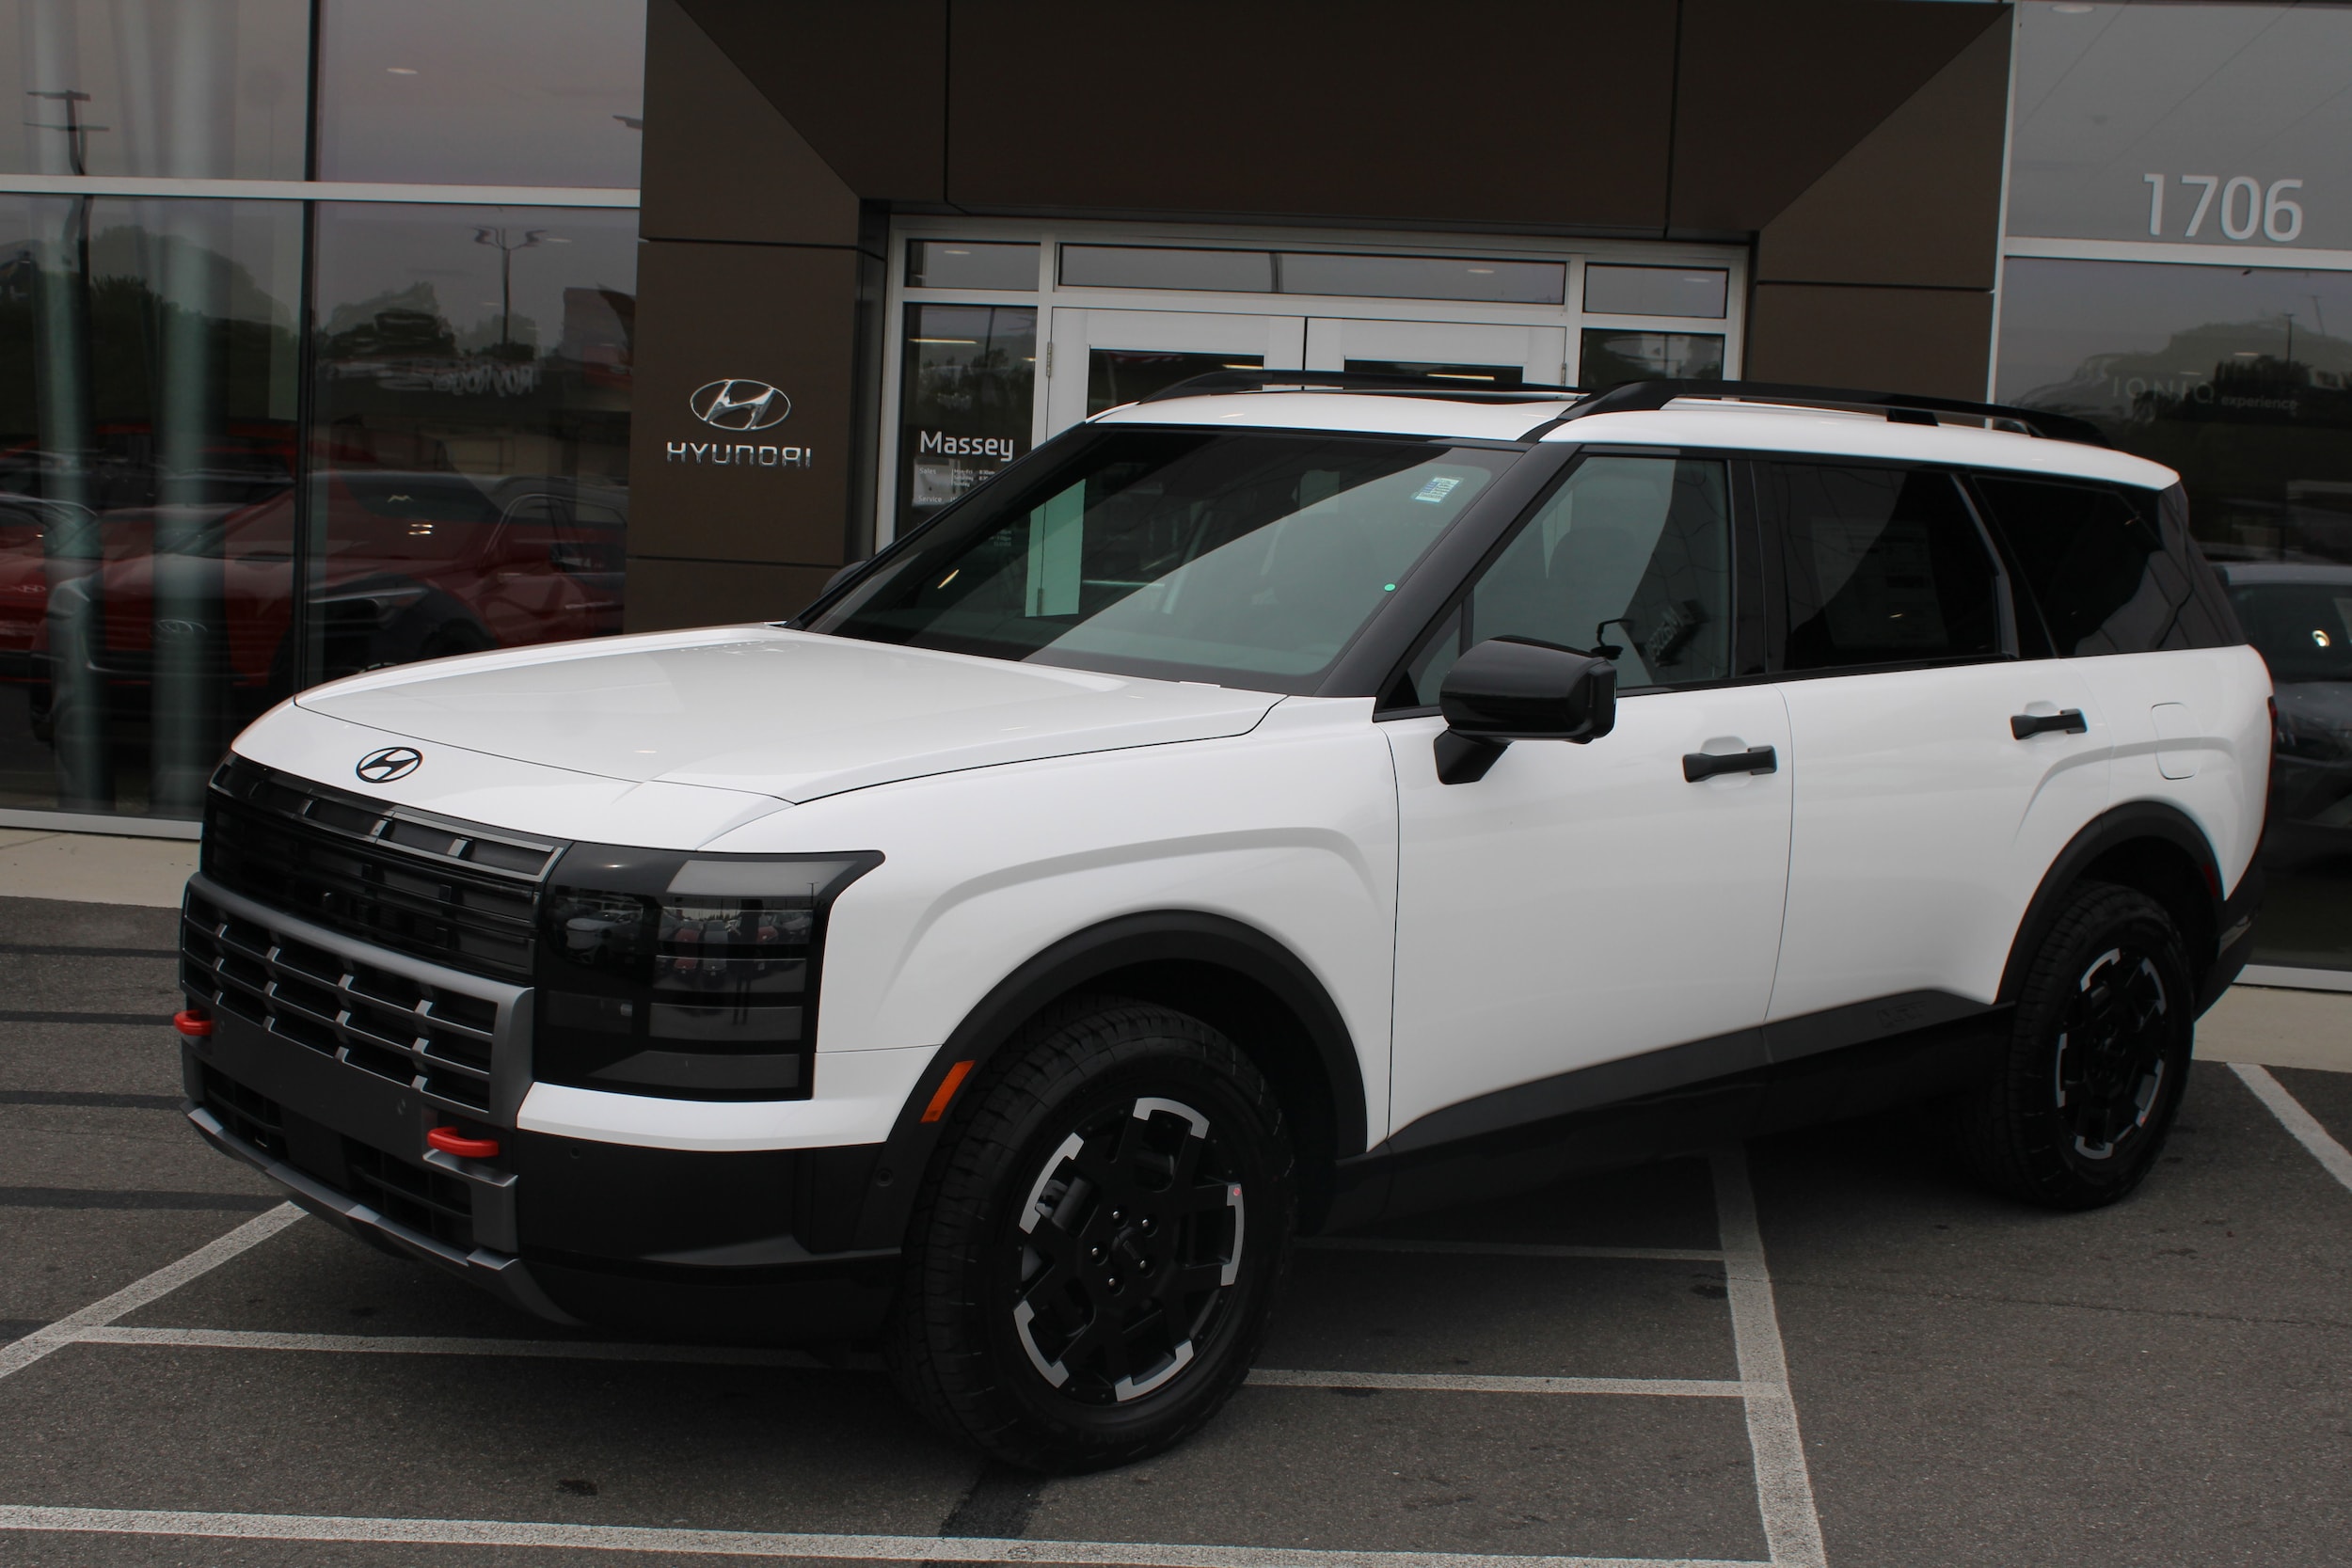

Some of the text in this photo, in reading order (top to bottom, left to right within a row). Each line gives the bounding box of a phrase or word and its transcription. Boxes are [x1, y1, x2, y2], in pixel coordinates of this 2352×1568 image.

[2143, 172, 2304, 243] 1706
[2113, 376, 2298, 411] IONIQ experience
[666, 441, 812, 468] HYUNDAI
[920, 430, 1014, 462] Massey
[918, 495, 943, 503] Service
